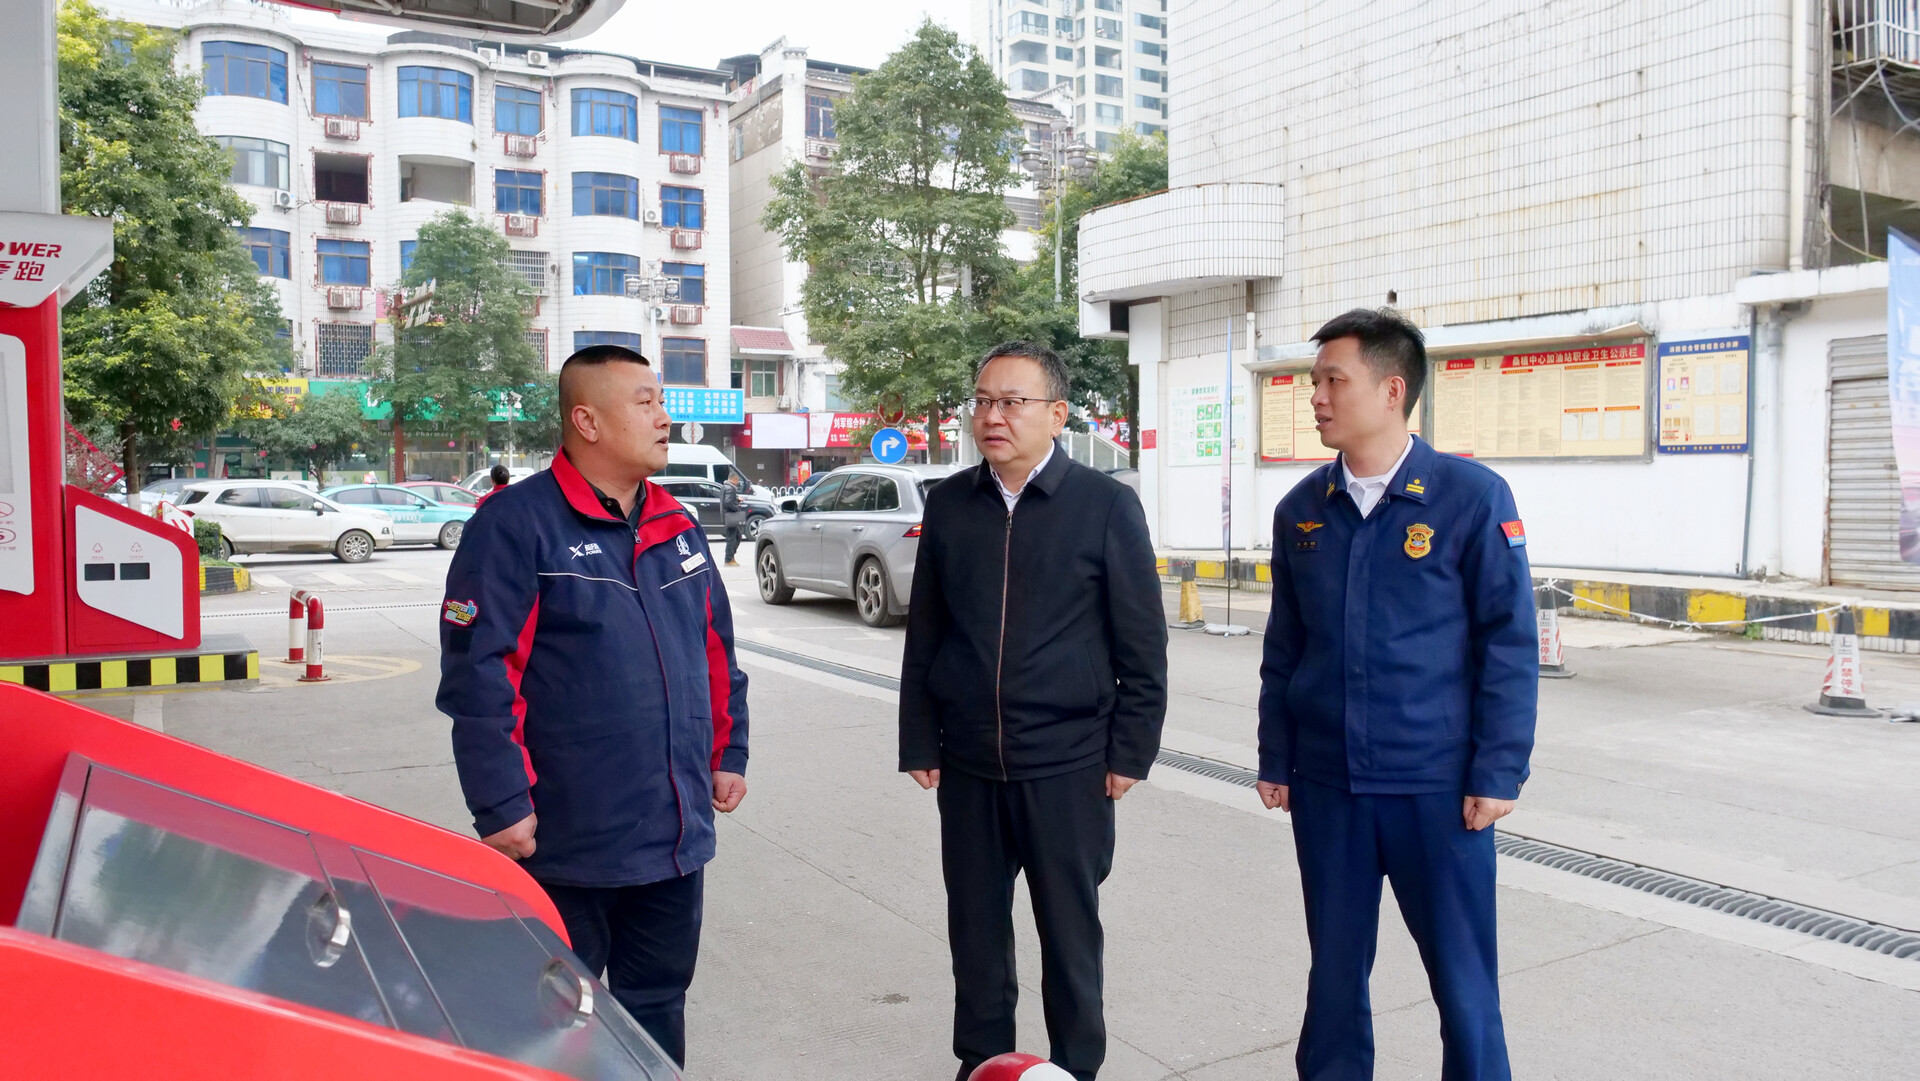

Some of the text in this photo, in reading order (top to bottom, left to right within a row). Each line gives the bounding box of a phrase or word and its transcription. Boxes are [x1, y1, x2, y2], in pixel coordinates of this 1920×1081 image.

[1512, 347, 1638, 367] 桑植中心加油站职业卫生公示栏
[415, 430, 453, 439] Pharmacy
